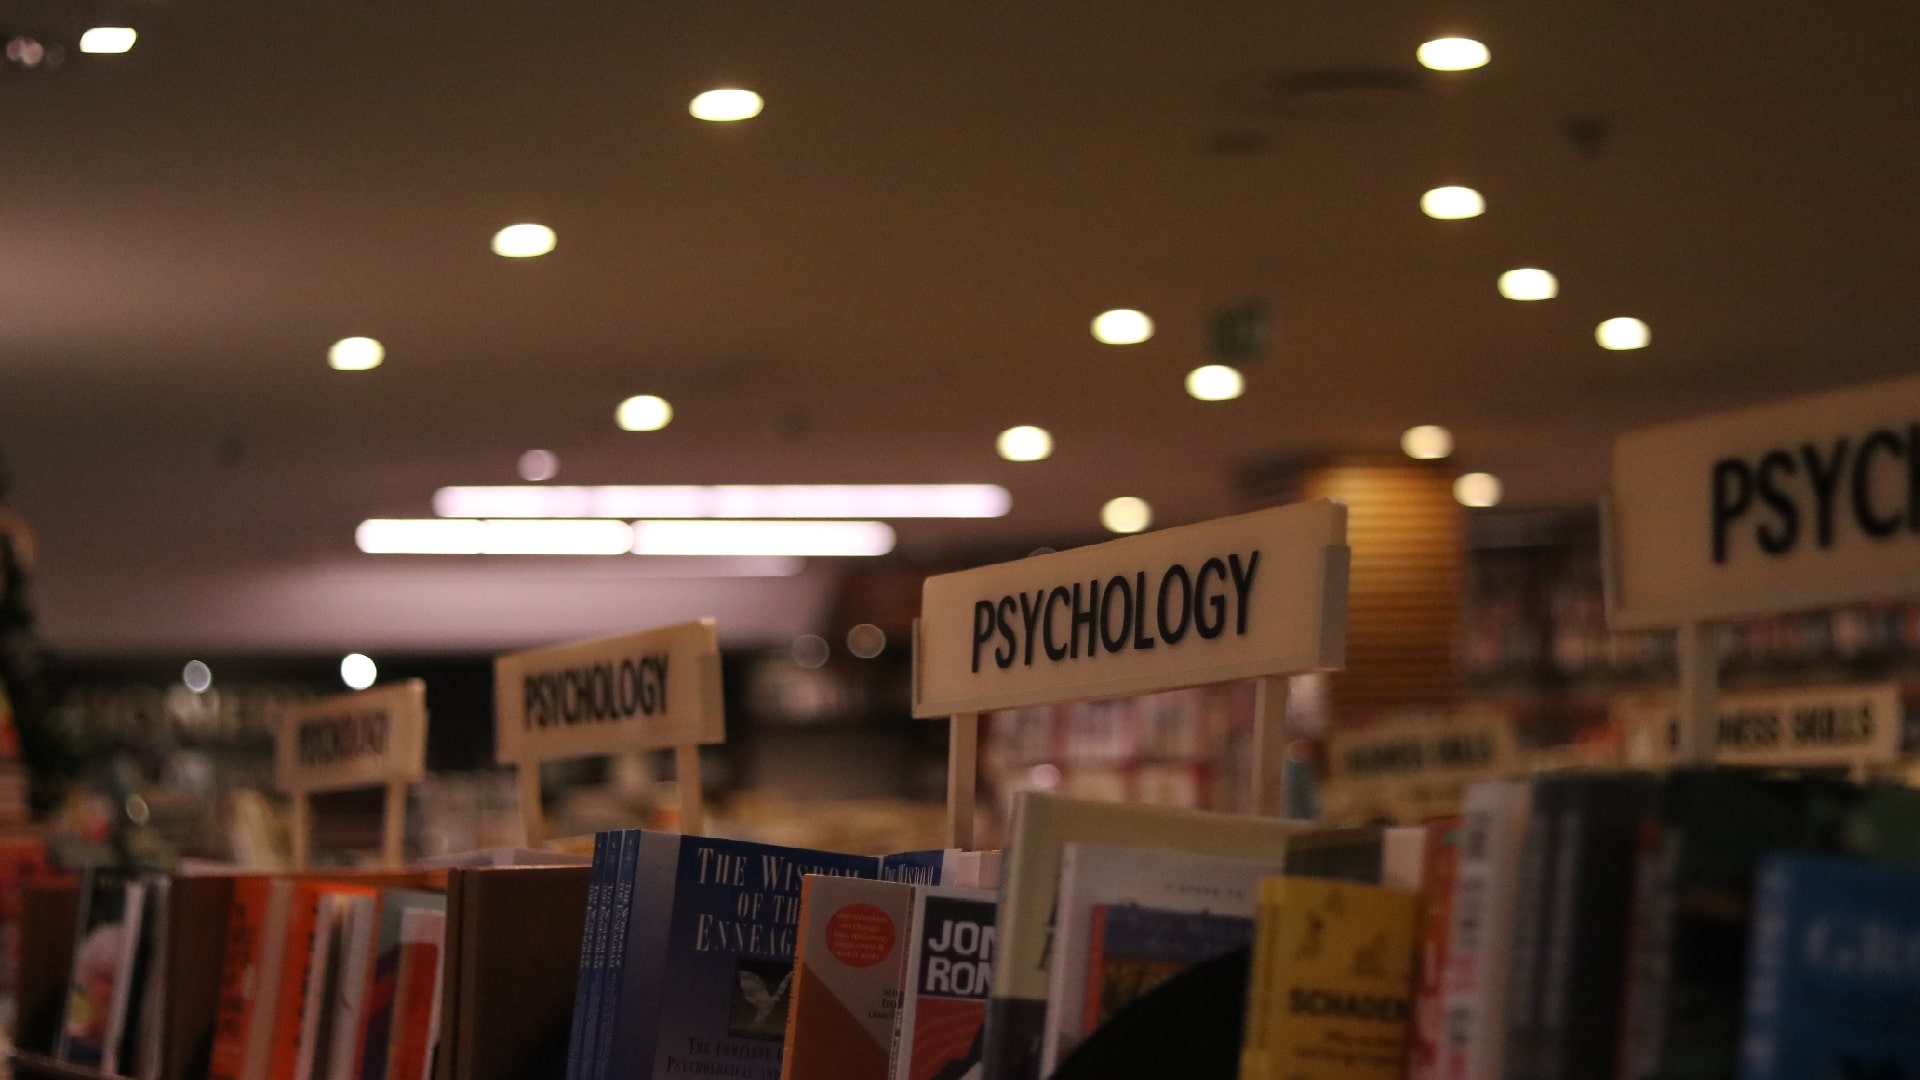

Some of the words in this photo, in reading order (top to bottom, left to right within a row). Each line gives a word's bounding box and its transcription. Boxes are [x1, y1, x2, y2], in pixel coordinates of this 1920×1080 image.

[971, 550, 1259, 674] PSYCHOLOGY
[523, 653, 669, 731] PSYCHOLOGY
[697, 847, 747, 886] THE
[737, 892, 764, 919] OF
